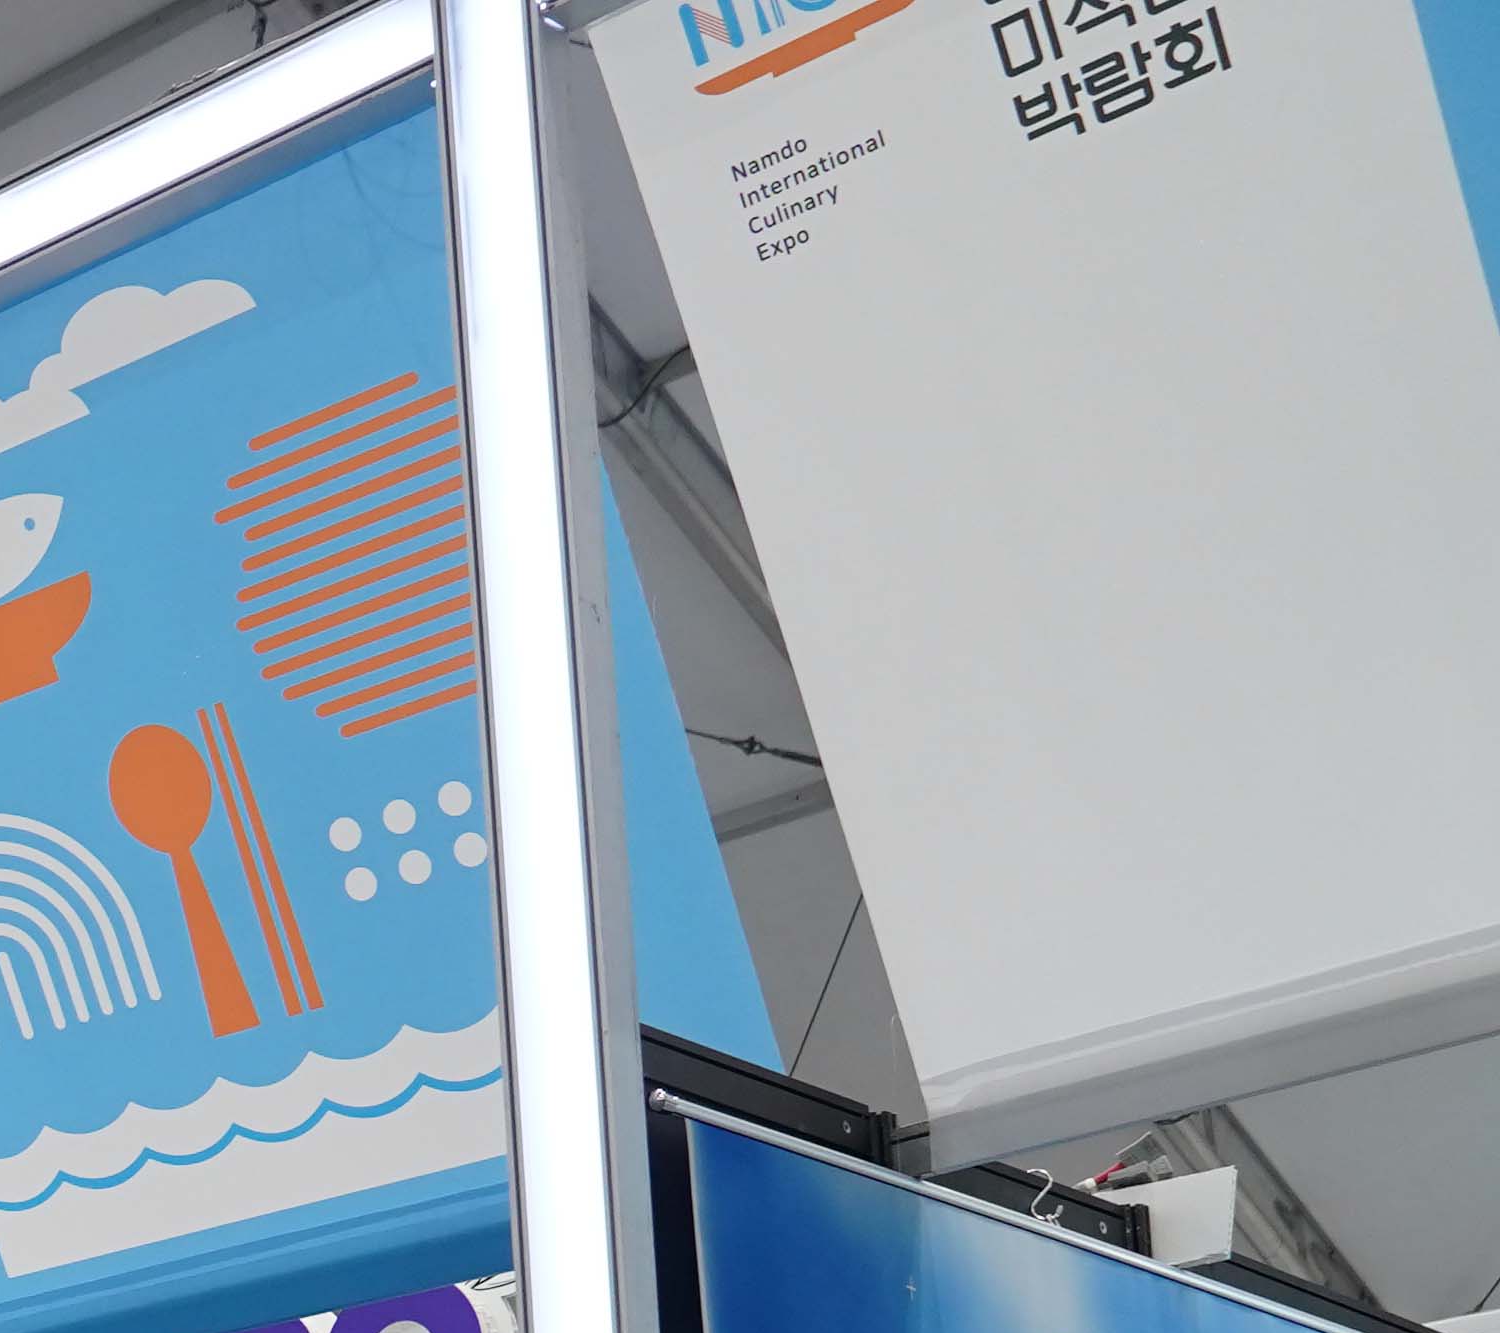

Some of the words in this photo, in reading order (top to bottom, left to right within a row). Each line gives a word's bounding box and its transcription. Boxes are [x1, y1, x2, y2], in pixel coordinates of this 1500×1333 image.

[1012, 5, 1232, 141] 박람회
[731, 136, 807, 182] Namdo
[739, 130, 886, 208] International
[748, 183, 839, 235] Culinary
[756, 228, 810, 262] Expo
